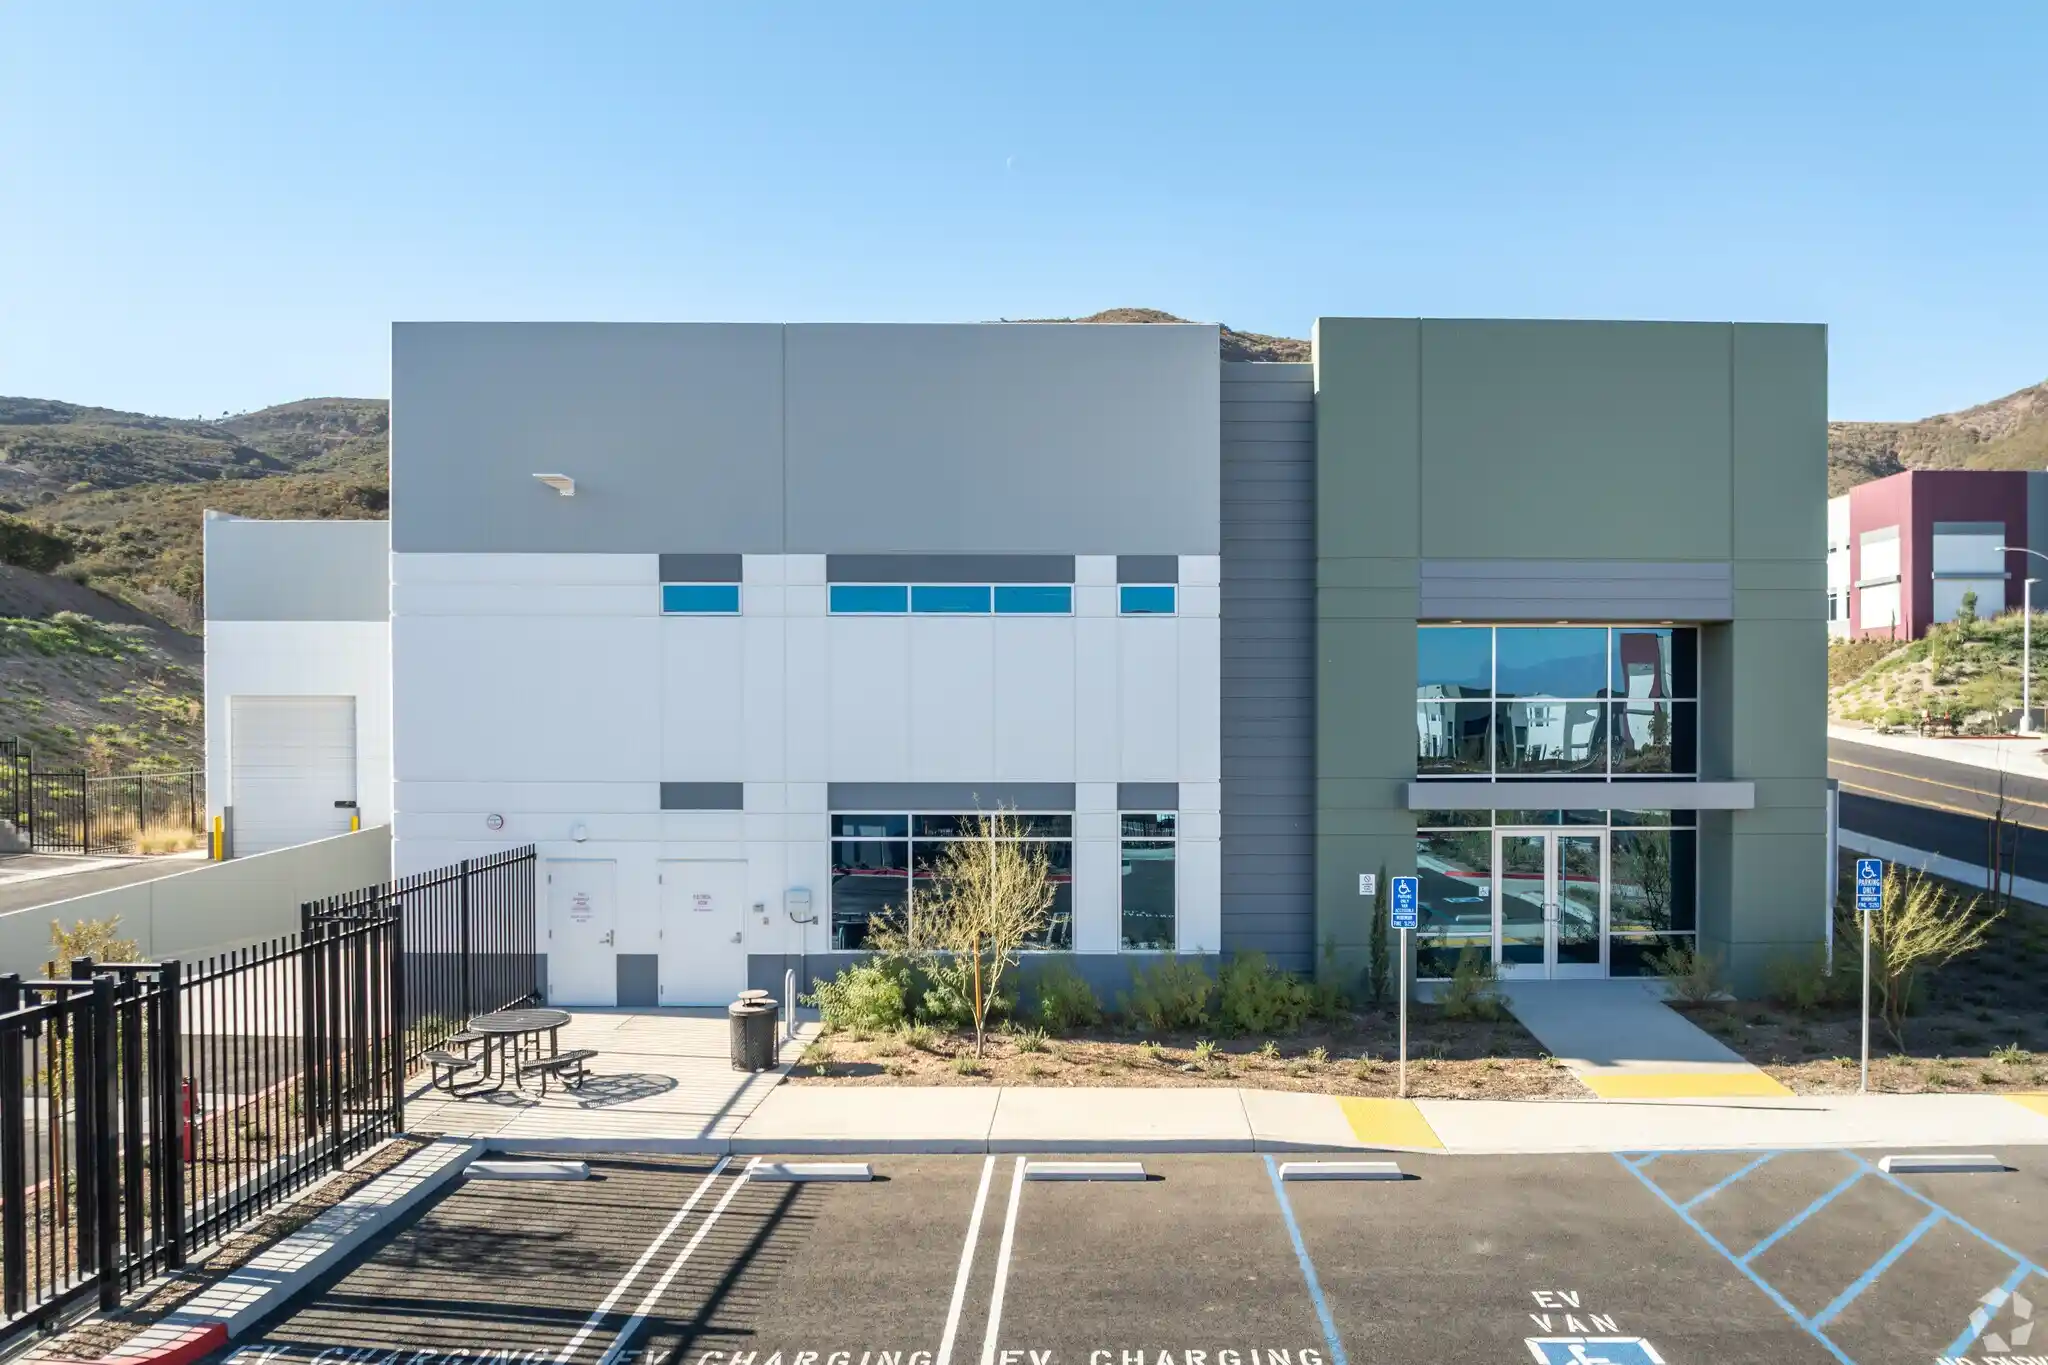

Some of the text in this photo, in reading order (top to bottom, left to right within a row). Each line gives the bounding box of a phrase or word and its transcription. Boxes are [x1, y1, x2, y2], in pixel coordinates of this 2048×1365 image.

[1531, 1291, 1580, 1308] EV
[1529, 1313, 1620, 1332] VAN
[696, 1351, 932, 1365] CHARGING
[1000, 1349, 1323, 1365] EV CHARGING
